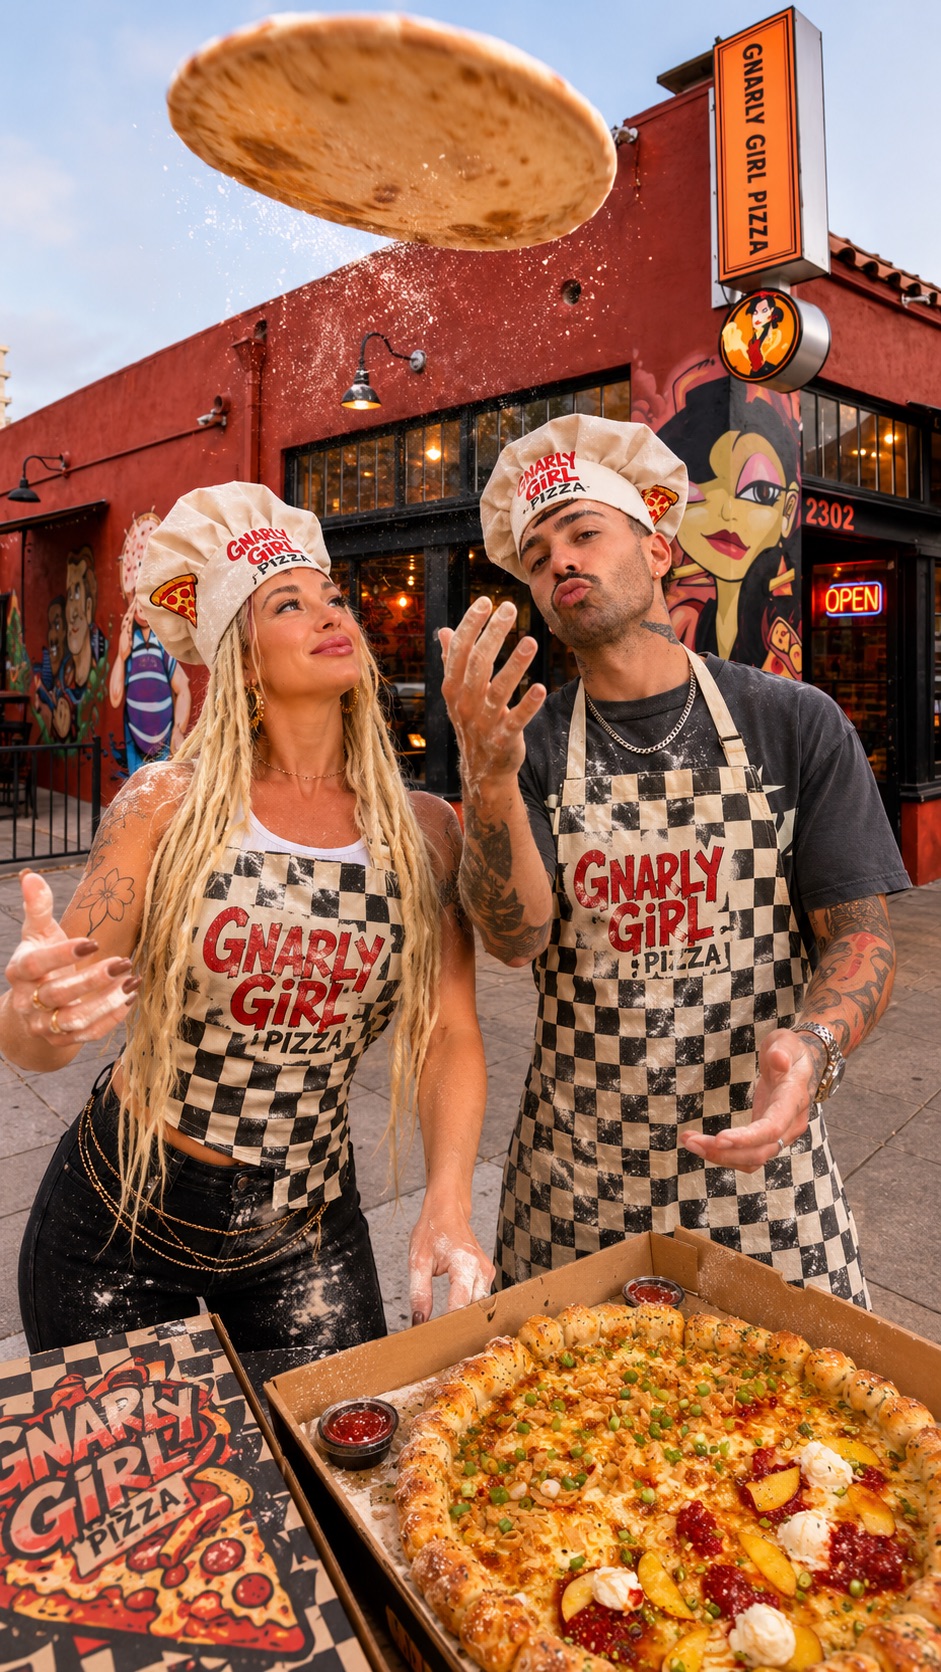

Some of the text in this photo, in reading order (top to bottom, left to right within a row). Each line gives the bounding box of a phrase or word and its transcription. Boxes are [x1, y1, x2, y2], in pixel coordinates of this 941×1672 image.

[743, 43, 769, 256] GNARLY GIRL PIZZA
[517, 451, 576, 497] GNARLY
[530, 482, 587, 509] PIZZA
[805, 497, 855, 531] 2302
[227, 527, 293, 562] GNARLY
[257, 553, 312, 575] PIZZA
[825, 585, 879, 612] OPEN
[573, 845, 725, 912] GNARLY
[202, 906, 386, 993] GNARLY
[262, 1029, 343, 1054] PIZZA
[85, 1488, 182, 1557] PIZZA
